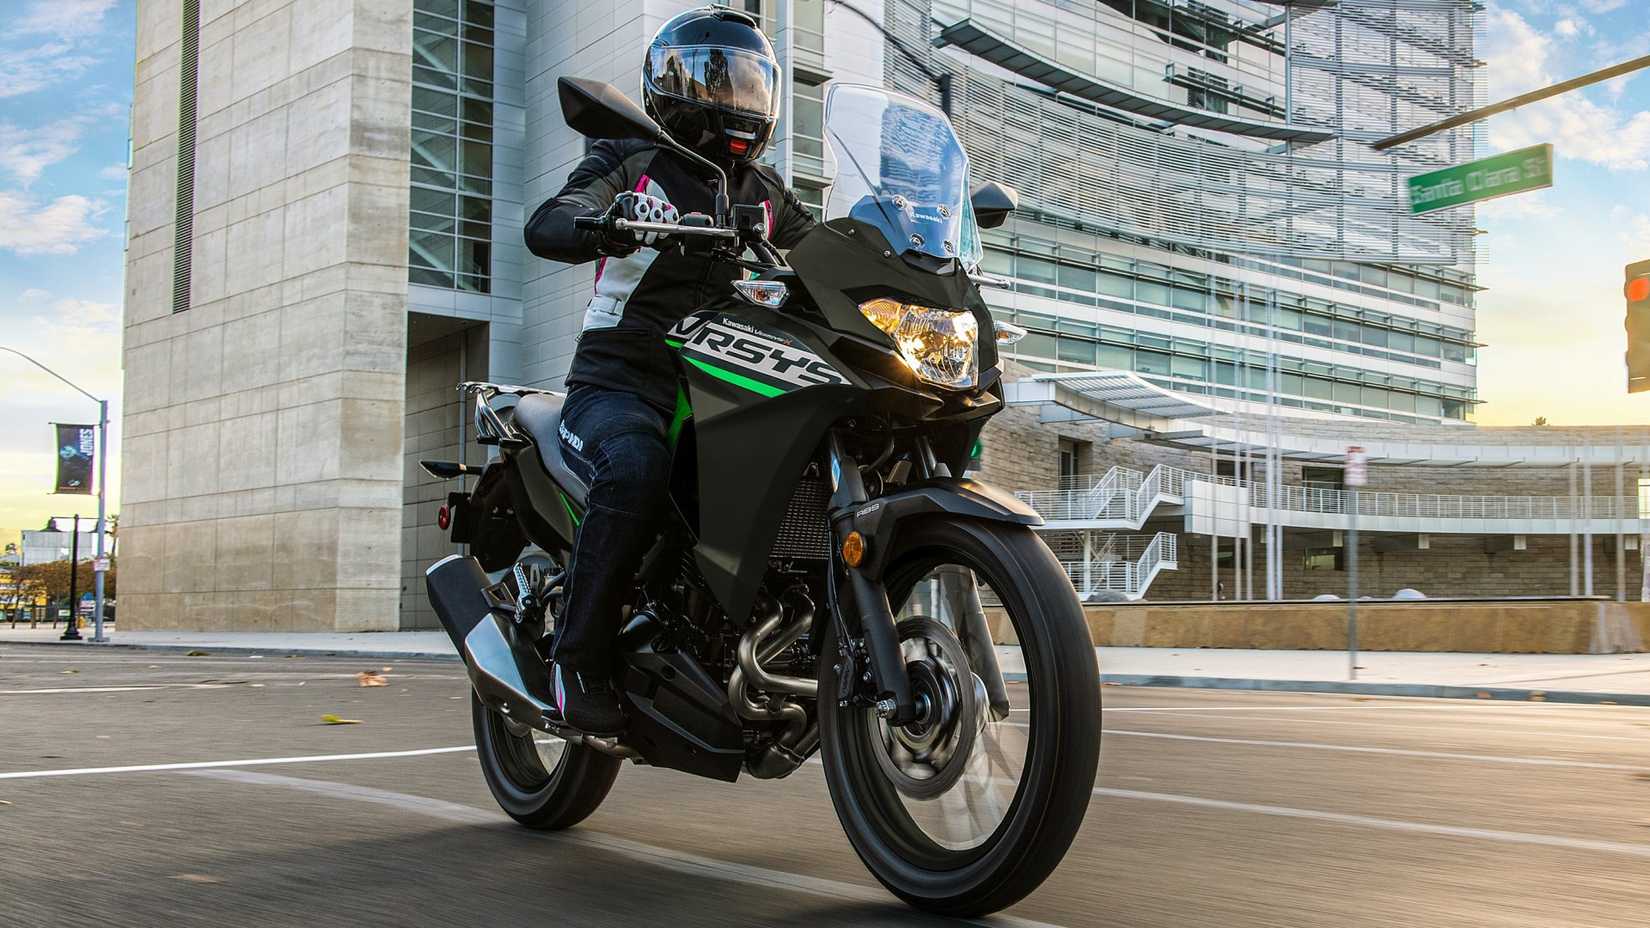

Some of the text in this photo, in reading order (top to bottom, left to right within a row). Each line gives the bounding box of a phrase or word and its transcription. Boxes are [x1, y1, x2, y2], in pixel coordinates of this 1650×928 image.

[1412, 180, 1464, 203] Santa
[1466, 167, 1520, 191] Clara
[722, 317, 754, 333] Kawasaki
[856, 503, 880, 518] ABS
